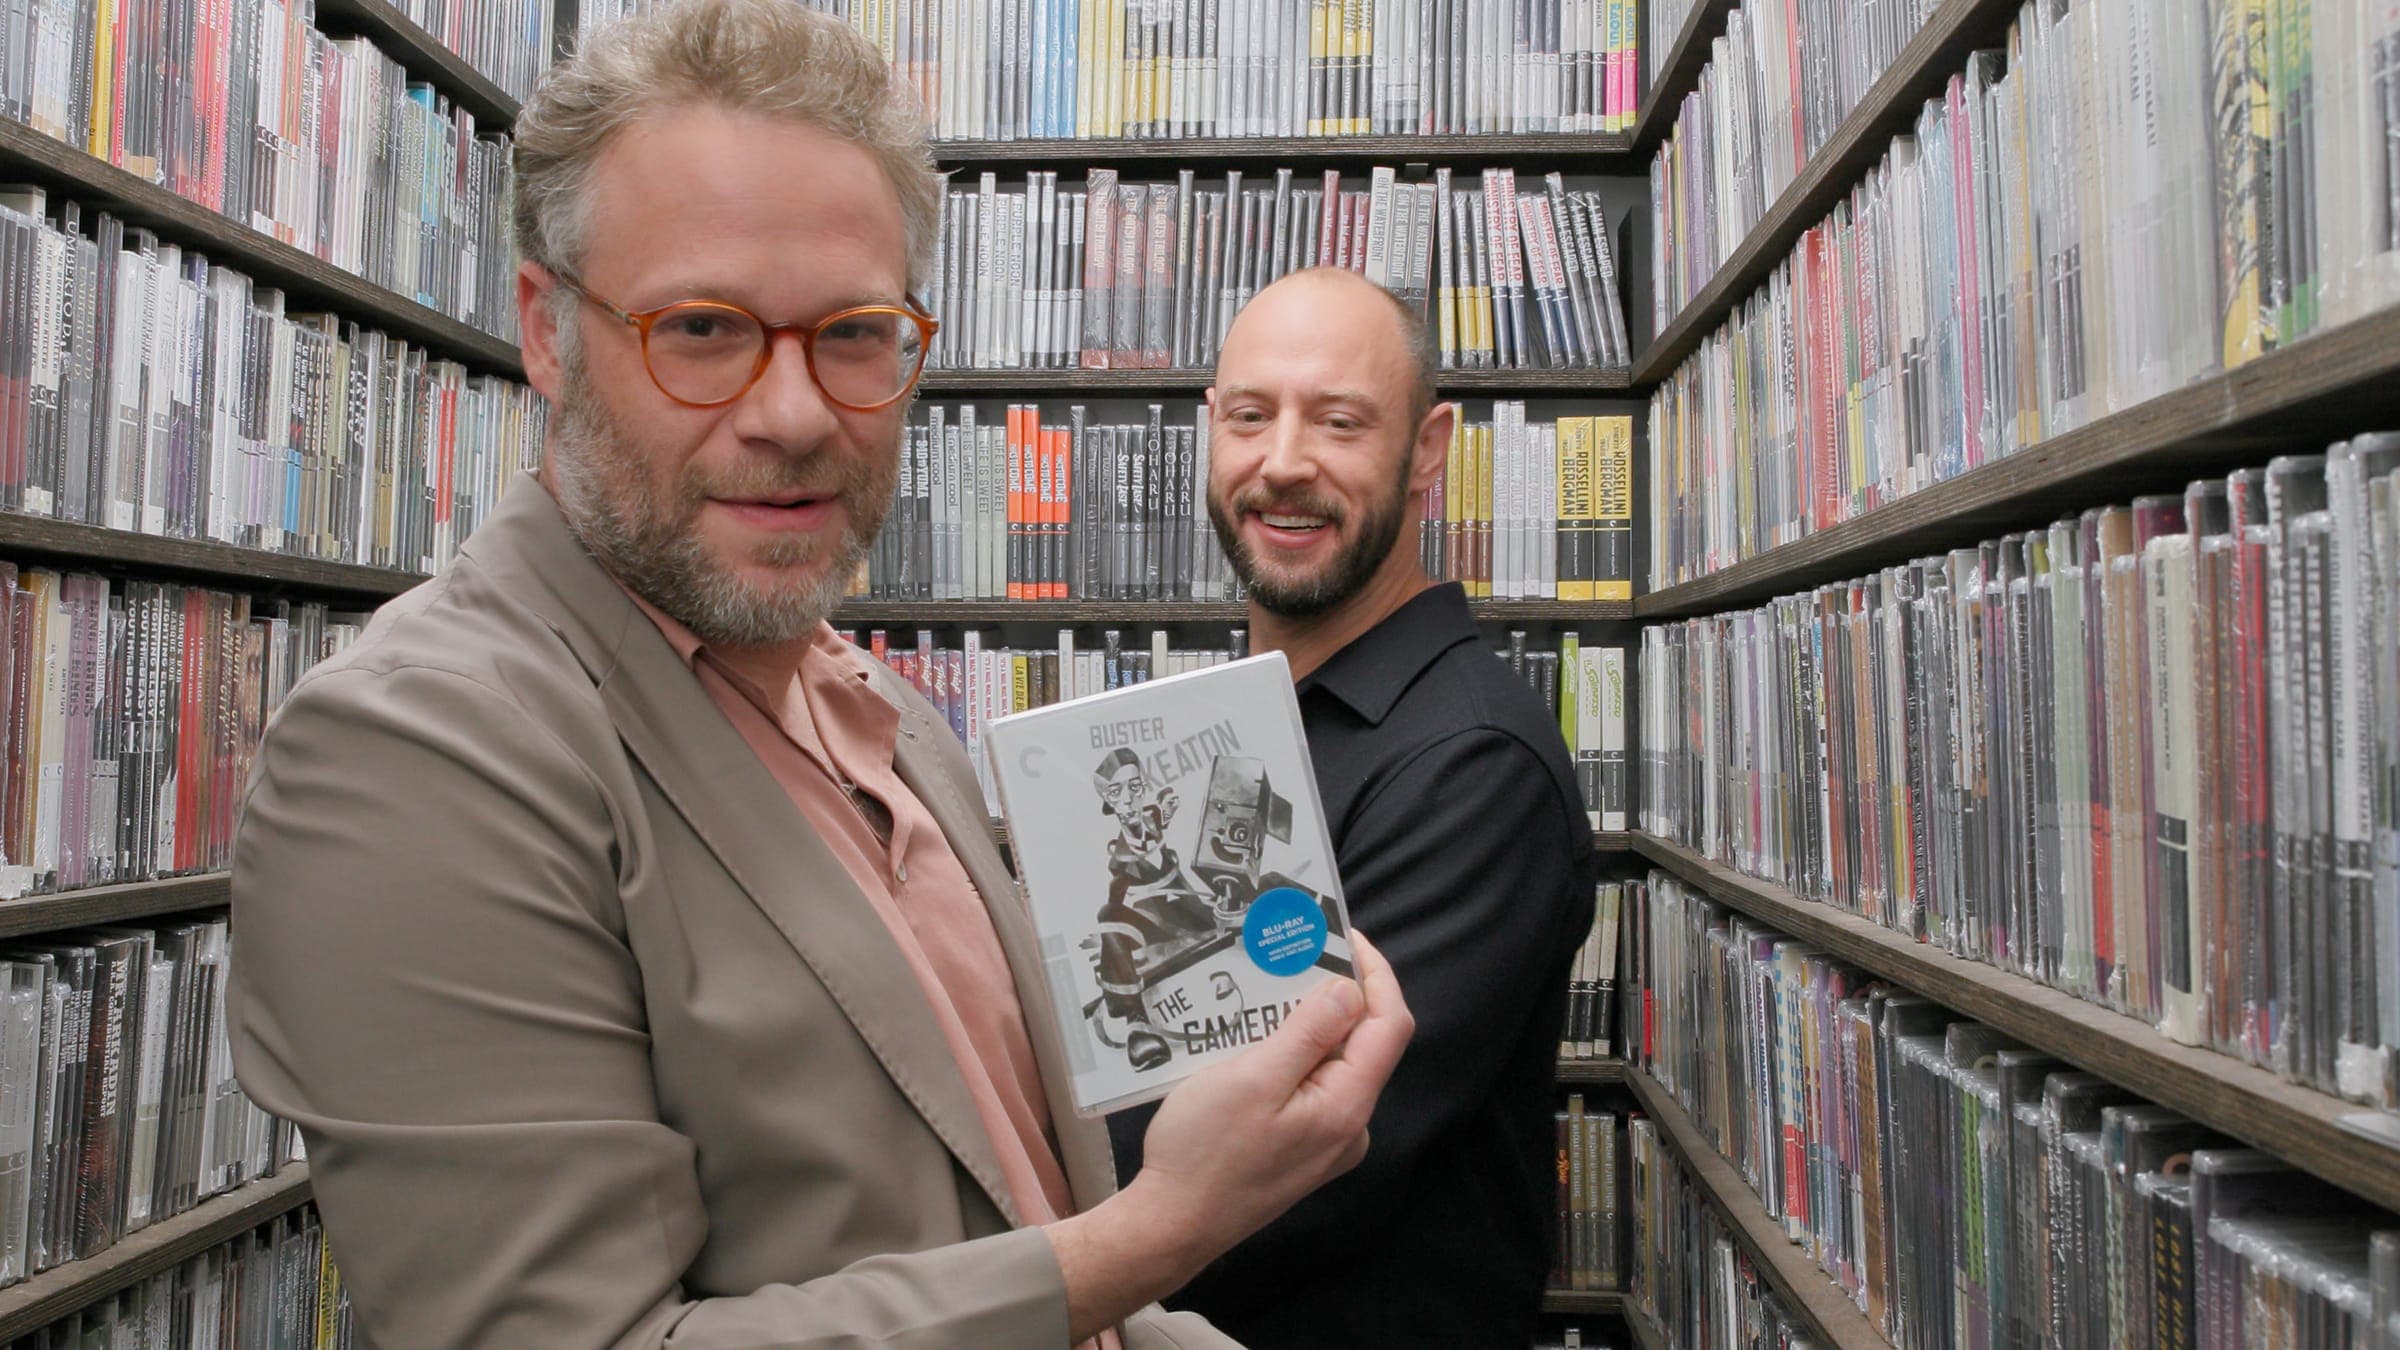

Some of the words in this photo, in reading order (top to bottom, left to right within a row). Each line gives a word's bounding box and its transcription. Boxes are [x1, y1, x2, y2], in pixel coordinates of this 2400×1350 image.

[1610, 2, 1622, 48] RAOUL
[1625, 6, 1635, 43] RAOUL
[1376, 191, 1386, 206] THE
[1379, 177, 1388, 188] ON
[1398, 193, 1409, 205] ON
[1420, 194, 1430, 205] ON
[1485, 175, 1501, 231] MINISTRY
[1501, 175, 1518, 231] MINISTRY
[980, 193, 992, 240] PURPLE
[996, 199, 1007, 246] PURPLE
[1011, 203, 1023, 250] PURPLE
[1371, 208, 1385, 263] WATERFRONT
[1396, 207, 1408, 223] THE
[1417, 208, 1430, 223] THE
[1519, 200, 1538, 244] MINISTRY
[1539, 201, 1555, 244] MINISTRY
[1554, 206, 1569, 227] MAN
[1574, 213, 1589, 235] MAN
[1591, 213, 1605, 235] MAN
[979, 244, 990, 277] NOON
[1392, 224, 1407, 279] WATERFRONT
[1413, 225, 1428, 279] WATERFRONT
[1490, 235, 1503, 248] OF
[1506, 235, 1519, 248] OF
[1530, 247, 1542, 259] OF
[1548, 247, 1558, 259] OF
[1560, 230, 1579, 273] ESCAPED
[1578, 237, 1597, 278] ESCAPED
[1595, 237, 1614, 278] ESCAPED
[63, 221, 77, 315] UMBERTO
[995, 250, 1006, 283] NOON
[1010, 254, 1021, 287] NOON
[1491, 252, 1506, 281] FEAR
[1507, 252, 1522, 281] FEAR
[1532, 260, 1547, 284] FEAR
[1551, 260, 1564, 284] FEAR
[43, 265, 53, 325] HONEYMOON
[53, 271, 63, 331] HONEYMOON
[74, 266, 88, 358] UMBERTO
[61, 322, 72, 339] D.
[84, 271, 97, 362] UMBERTO
[73, 363, 82, 381] D.
[83, 368, 92, 384] D.
[930, 416, 941, 460] medium
[963, 416, 973, 437] LIFE
[963, 441, 973, 450] IS
[947, 437, 958, 482] medium
[979, 441, 989, 462] LIFE
[979, 465, 989, 475] IS
[995, 440, 1005, 460] LIFE
[995, 464, 1005, 473] IS
[917, 466, 928, 499] YUMA
[932, 462, 942, 485] cool
[963, 455, 974, 490] SWEET
[1009, 468, 1022, 492] COME
[1024, 469, 1036, 493] COME
[1041, 478, 1053, 503] COME
[1056, 478, 1068, 503] COME
[1148, 439, 1160, 511] OHARU
[1164, 452, 1177, 517] OHARU
[1180, 452, 1192, 516] OHARU
[1561, 459, 1575, 515] BERGMAN
[1575, 451, 1589, 515] ROSSELLINI
[1599, 458, 1613, 515] BERGMAN
[1614, 451, 1627, 515] ROSSELLINI
[948, 483, 958, 507] cool
[979, 479, 989, 514] SWEET
[995, 478, 1005, 512] SWEET
[2289, 557, 2302, 641] HIGH
[2306, 545, 2320, 631] HIGH
[86, 600, 98, 642] KING
[126, 598, 137, 651] YOUTH
[139, 599, 149, 653] YOUTH
[149, 599, 159, 668] FIGHTING
[161, 599, 171, 668] FIGHTING
[169, 611, 178, 653] CASQUE
[177, 613, 186, 655] CASQUE
[222, 608, 232, 657] NIGHT
[97, 630, 106, 693] KAGEMUSHA
[175, 659, 184, 684] D'OR
[233, 634, 242, 683] NIGHT
[920, 655, 932, 687] Thief
[950, 662, 963, 695] Thief
[1015, 666, 1025, 678] LA
[69, 659, 81, 718] KINGS
[83, 660, 96, 718] KINGS
[124, 664, 134, 717] BEAST
[136, 667, 146, 718] BEAST
[147, 671, 157, 718] ELEGY
[158, 671, 168, 718] ELEGY
[932, 664, 944, 696] Thief
[1015, 679, 1024, 690] VIE
[1015, 690, 1024, 701] DE
[218, 684, 227, 724] CITY
[2291, 652, 2306, 775] SIERRA
[2309, 641, 2323, 767] SIERRA
[230, 709, 239, 748] CITY
[1089, 717, 1165, 749] BUSTER
[2335, 718, 2347, 759] MAN
[1141, 720, 1241, 791] KEATON
[2358, 794, 2369, 835] MAN
[1262, 915, 1304, 937] BLU-RAY
[1152, 987, 1193, 1023] THE
[103, 996, 115, 1073] CONFIDENTIAL
[105, 1006, 122, 1117] ARKADIN
[100, 1076, 109, 1118] REPORT
